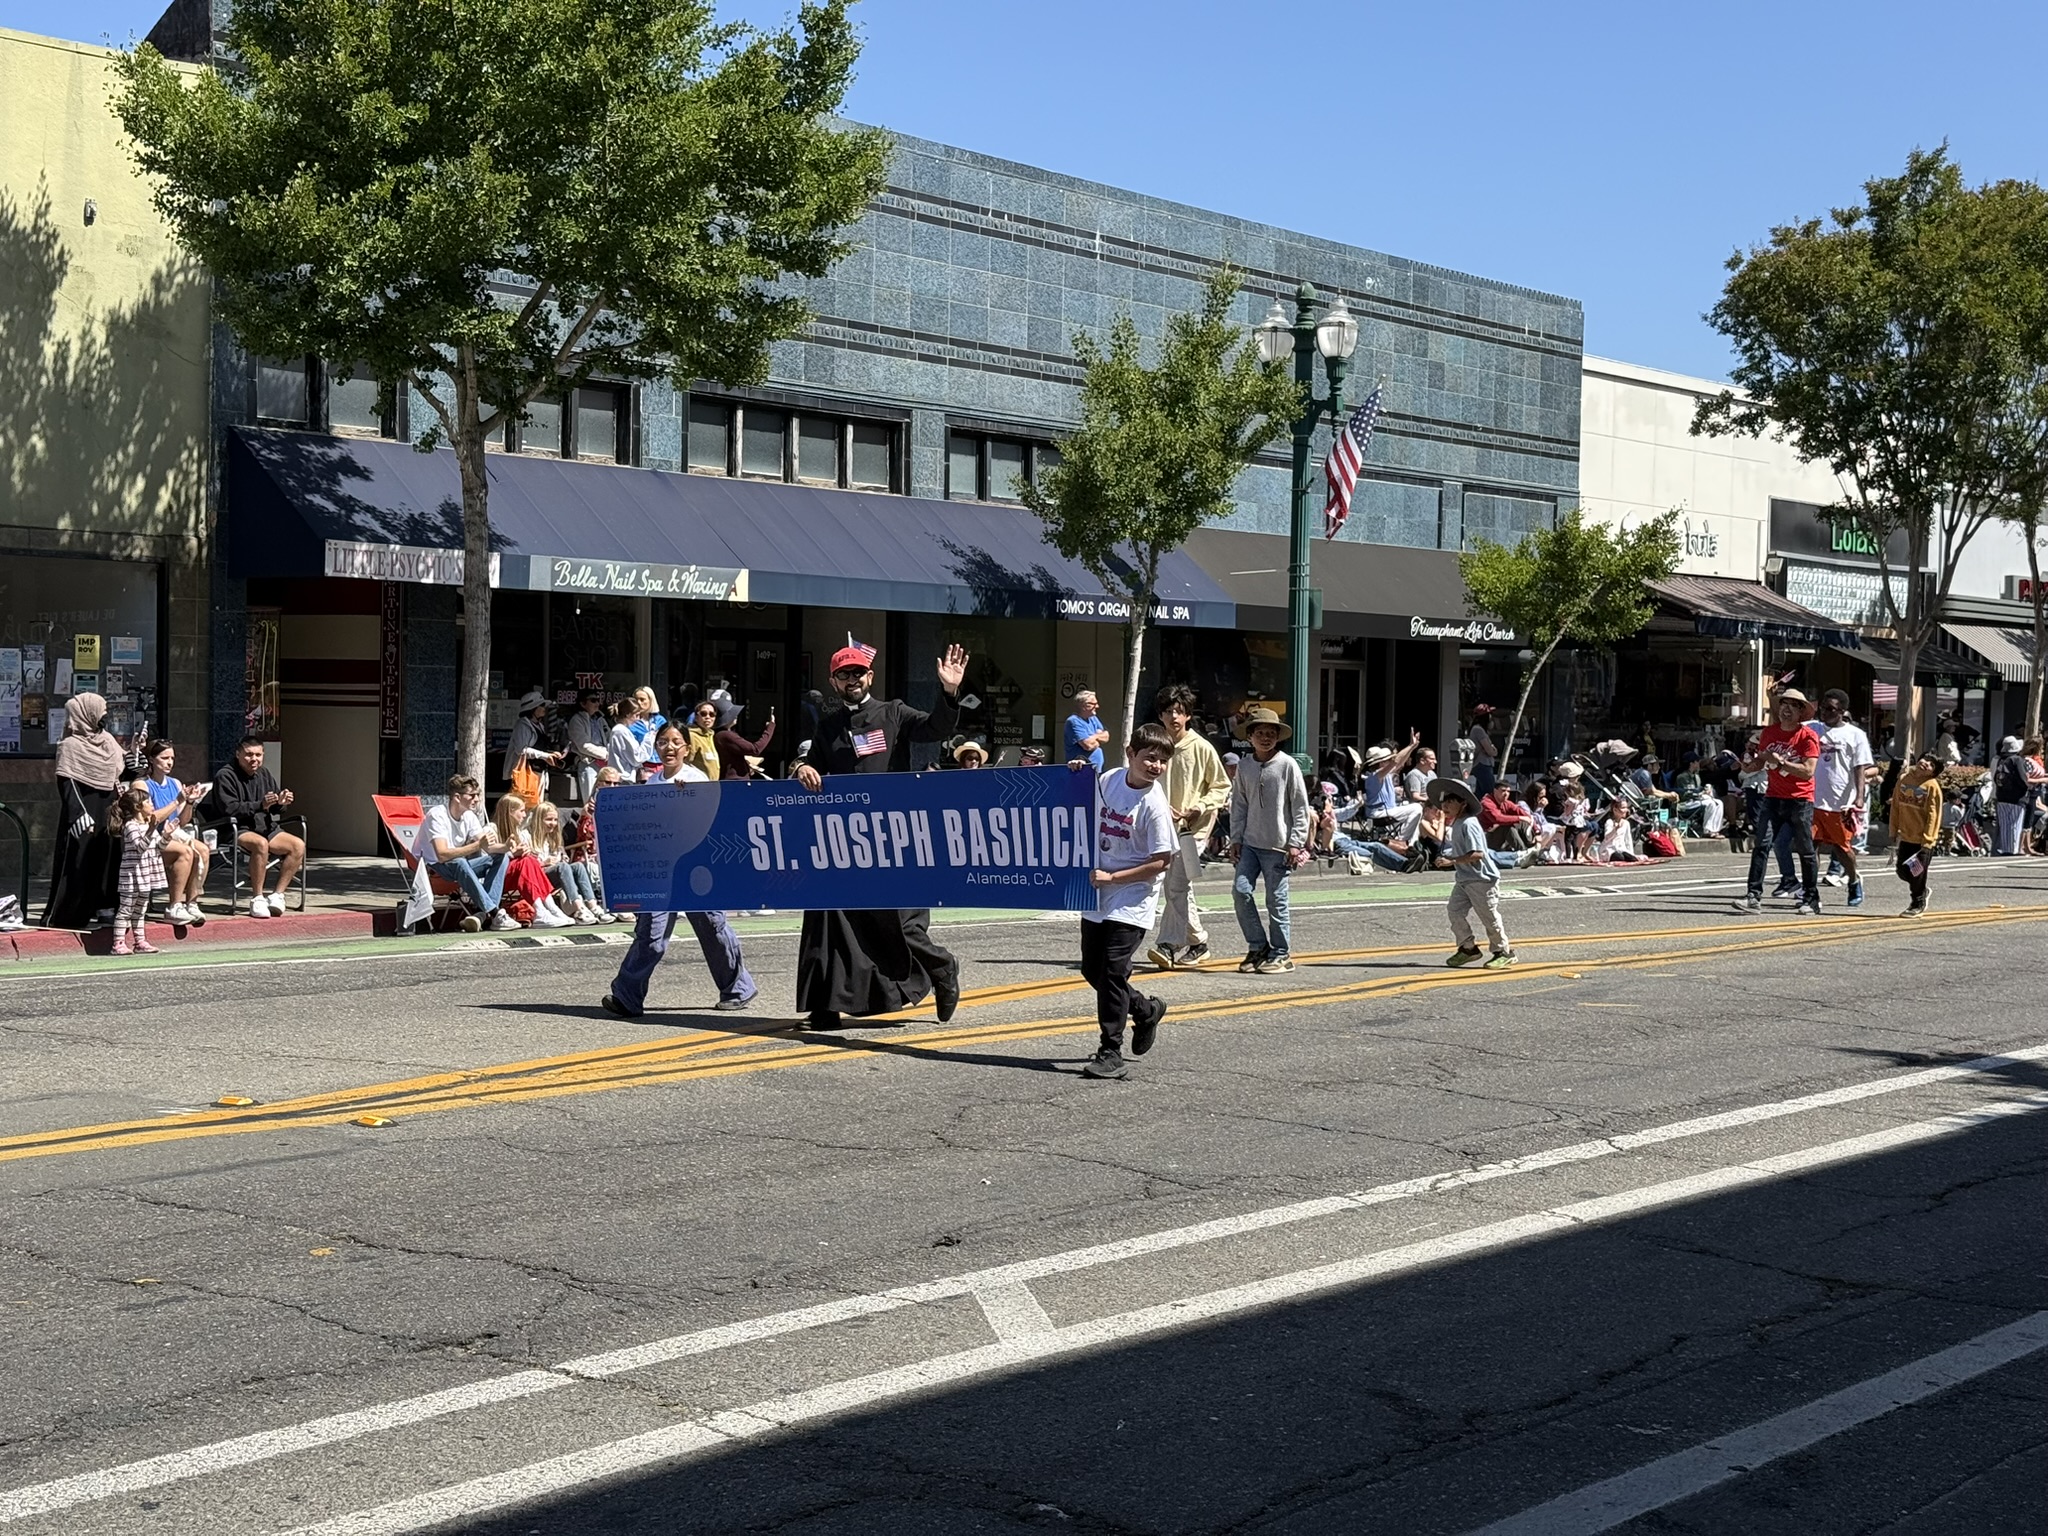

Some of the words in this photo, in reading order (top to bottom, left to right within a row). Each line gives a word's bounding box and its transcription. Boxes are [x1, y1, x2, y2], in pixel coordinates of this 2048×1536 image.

[333, 547, 386, 577] LITTLE
[390, 551, 451, 582] PSYCHIC
[554, 560, 598, 588] Bella
[600, 563, 636, 590] Nail
[638, 569, 663, 596] Spa
[668, 569, 680, 593] &
[681, 571, 728, 600] Waxing
[1056, 599, 1095, 615] TOMO'S
[1148, 605, 1169, 620] NAIL
[1172, 606, 1190, 621] SPA
[1483, 622, 1515, 641] Church
[78, 638, 96, 646] IMP
[575, 671, 604, 690] TK
[386, 665, 395, 728] TELLER
[660, 789, 697, 799] NOTRE
[766, 791, 871, 808] sjbalameda.org
[600, 804, 630, 813] DAME
[631, 803, 656, 812] HIGH
[605, 833, 674, 844] ELEMENTARY
[748, 815, 799, 871] ST.
[810, 810, 936, 870] JOSEPH
[942, 806, 1091, 868] BASILICA
[606, 845, 648, 854] SCHOOL
[608, 860, 656, 870] KNIGHTS
[657, 859, 671, 869] OF
[610, 872, 668, 882] COLUMBUS
[966, 872, 1030, 887] Alameda,
[1033, 872, 1055, 886] CA
